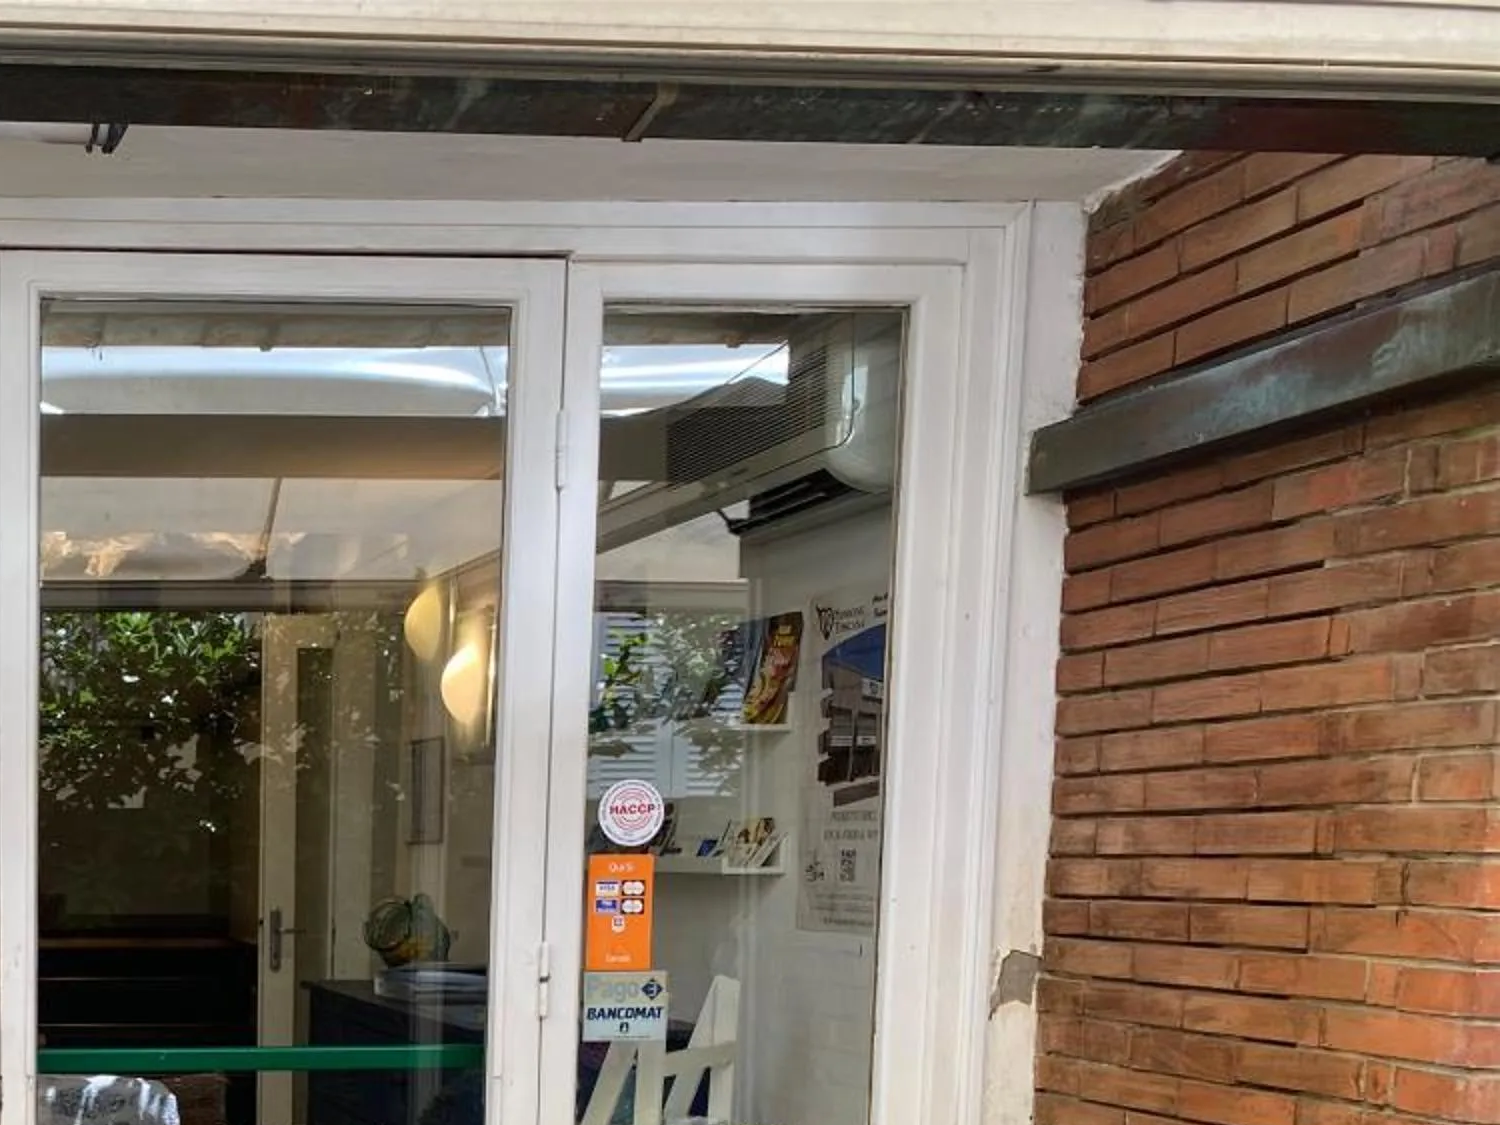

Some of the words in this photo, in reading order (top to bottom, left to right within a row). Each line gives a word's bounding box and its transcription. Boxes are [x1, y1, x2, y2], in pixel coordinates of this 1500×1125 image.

[609, 804, 654, 814] HACCP
[587, 975, 639, 1003] Pago
[587, 1007, 664, 1020] BANCOMAT
